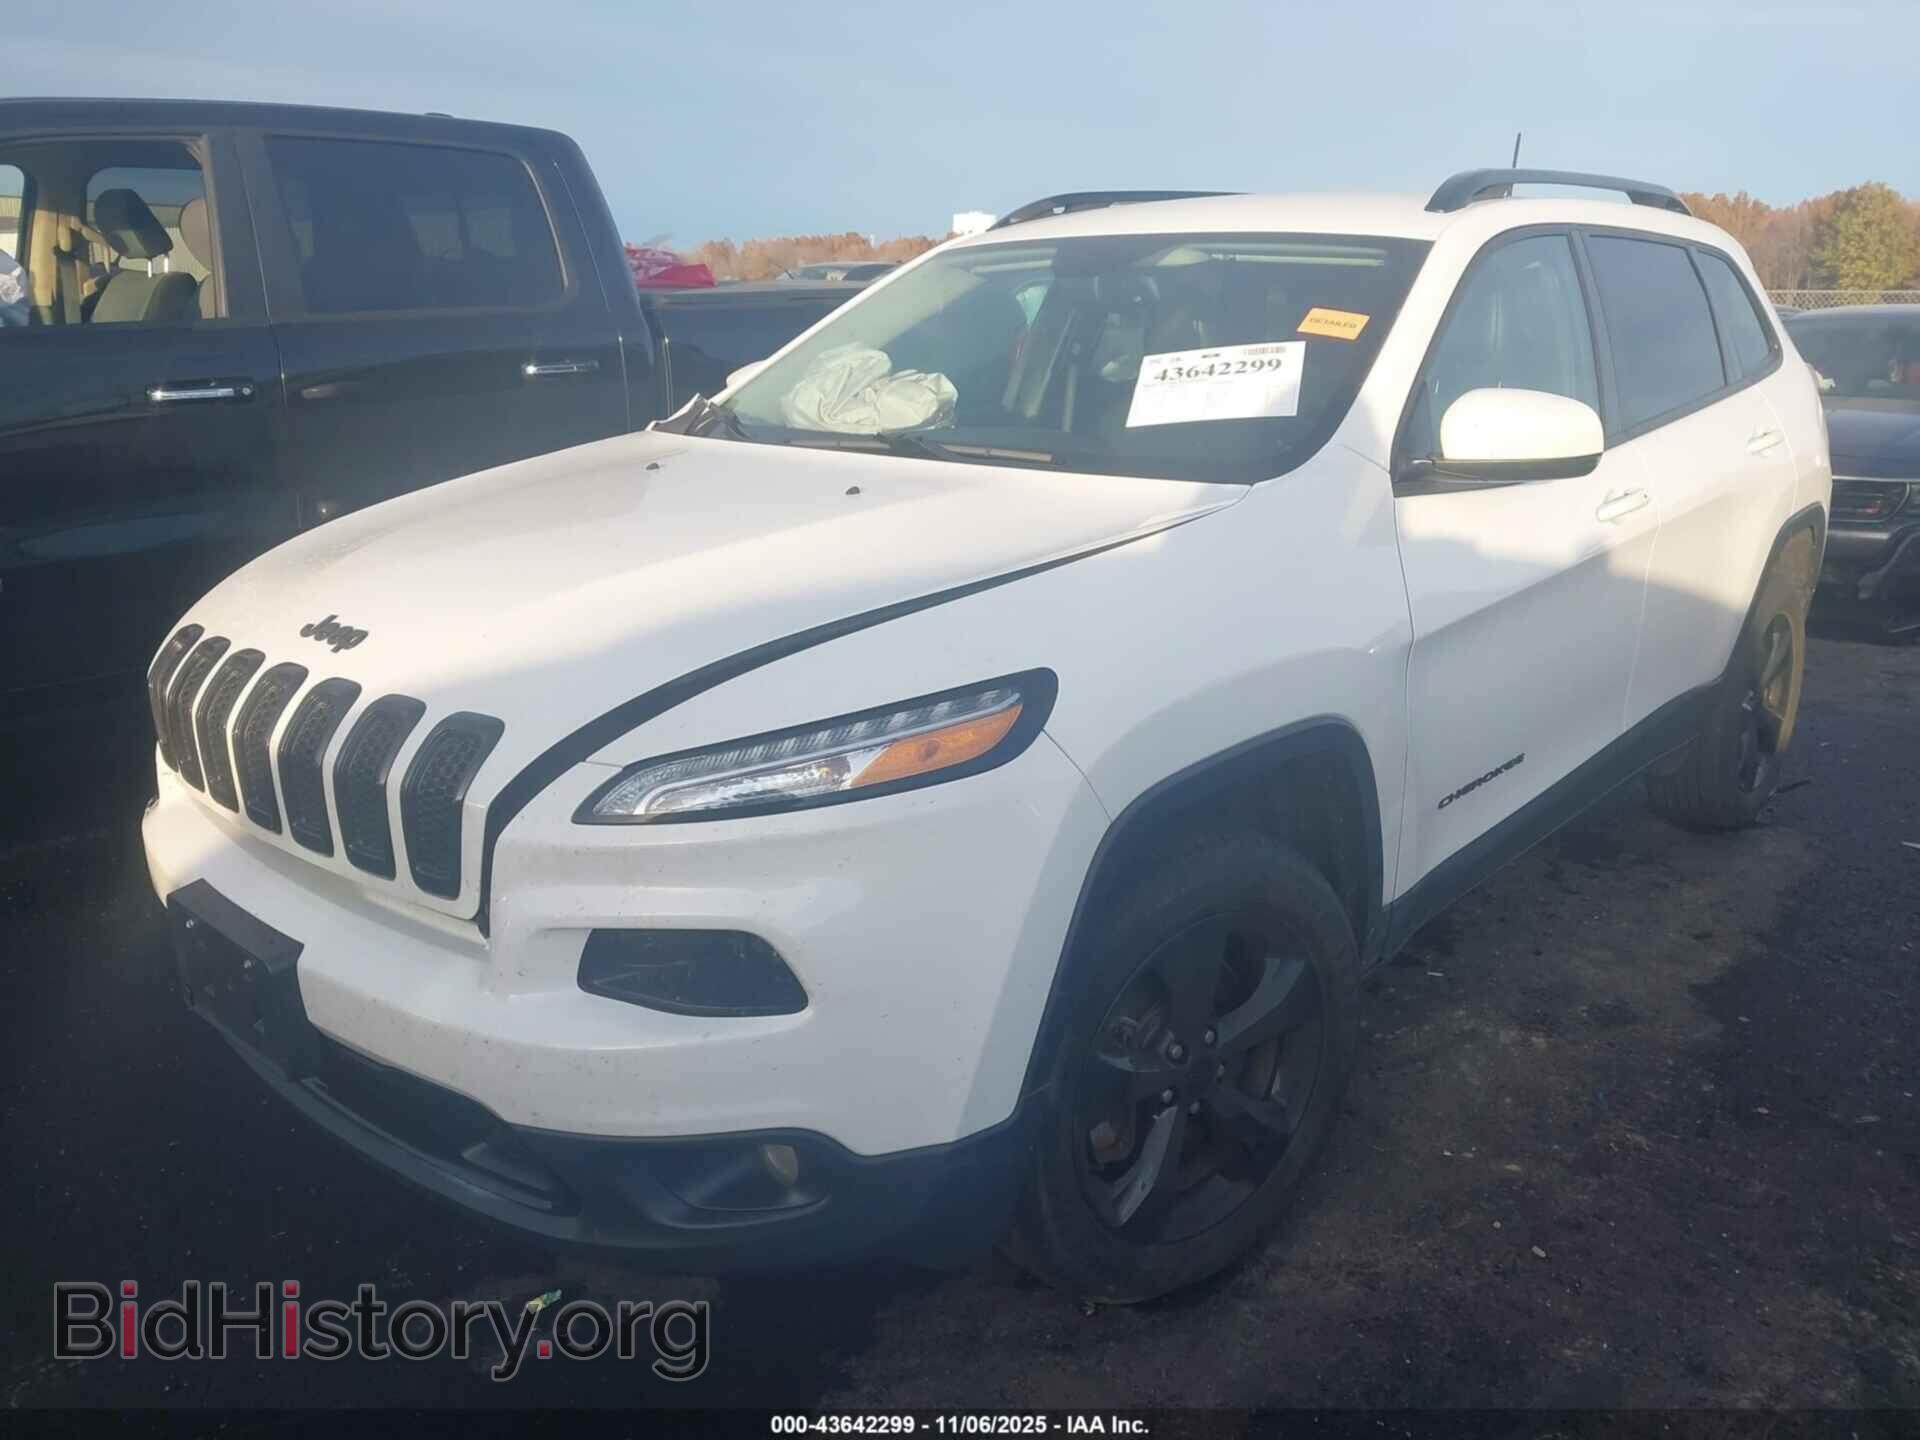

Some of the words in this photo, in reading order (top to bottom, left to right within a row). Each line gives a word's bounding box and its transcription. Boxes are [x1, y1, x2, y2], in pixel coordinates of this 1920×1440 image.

[1154, 358, 1282, 382] 43642299
[300, 614, 369, 653] Jeep
[1438, 752, 1525, 809] CHEROKEE
